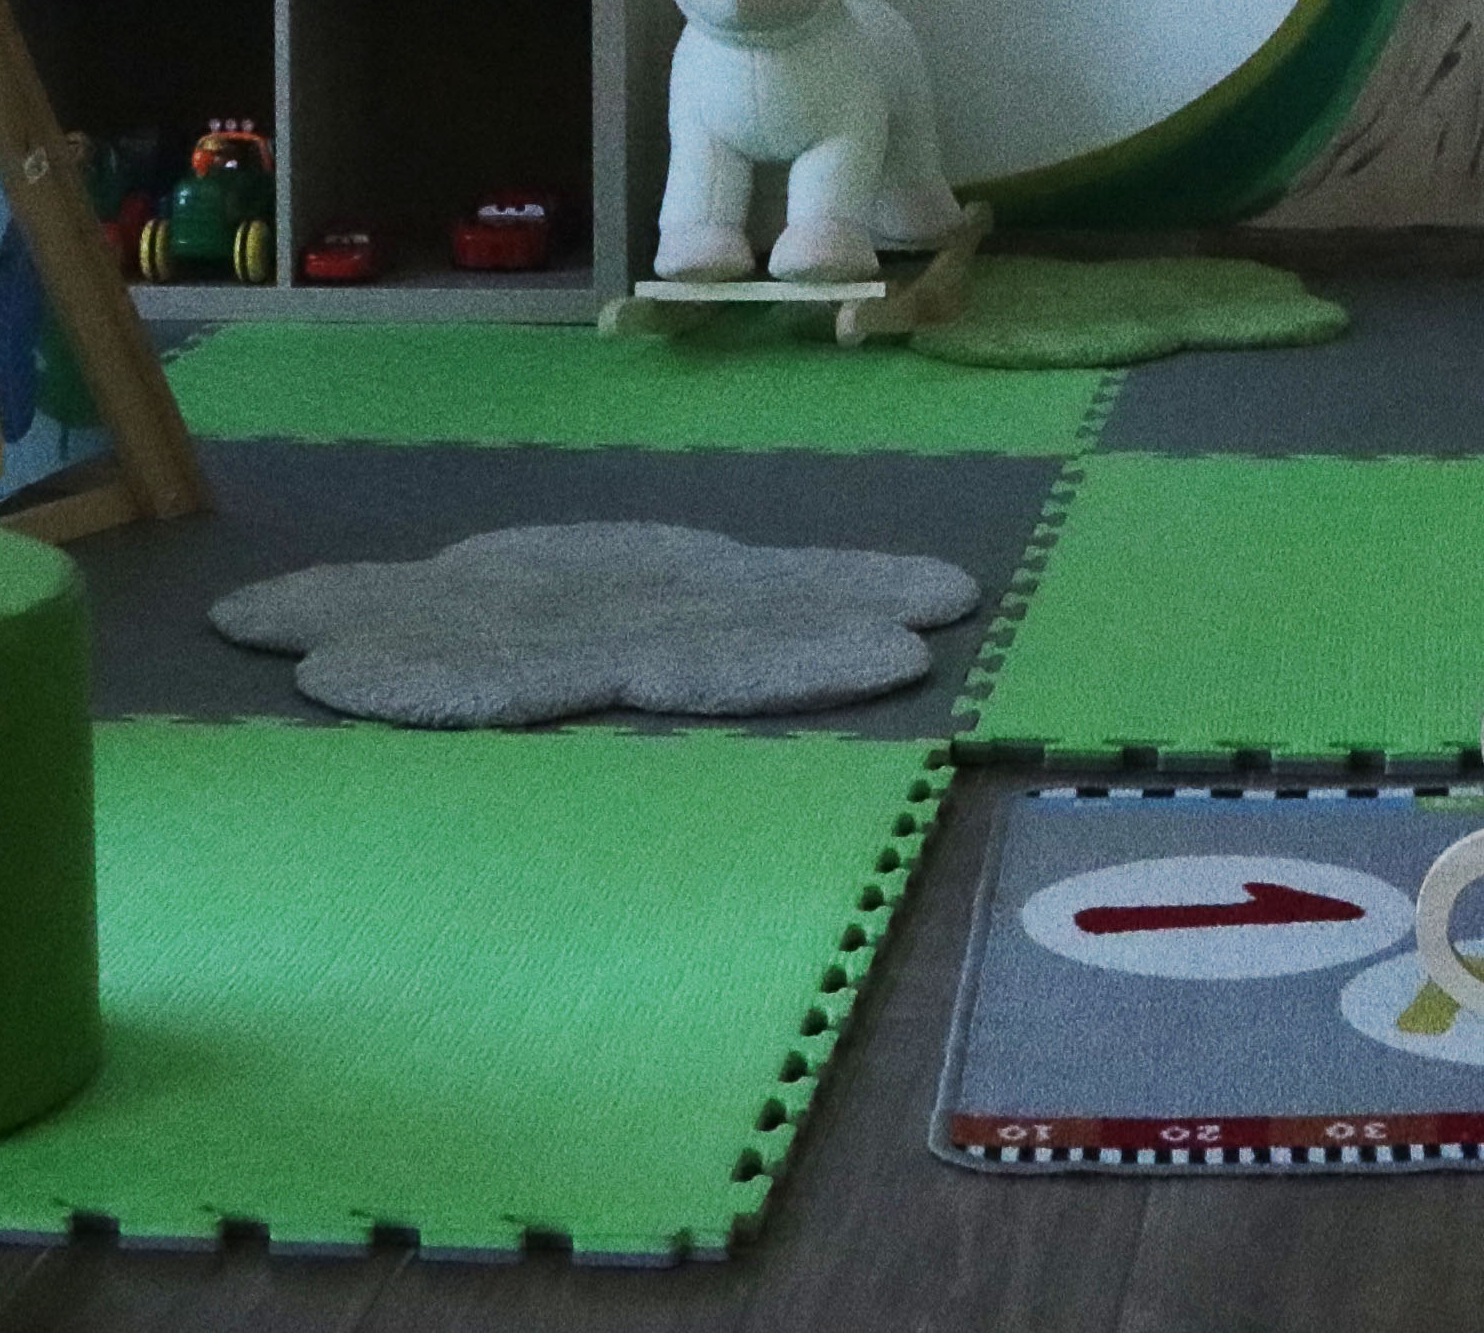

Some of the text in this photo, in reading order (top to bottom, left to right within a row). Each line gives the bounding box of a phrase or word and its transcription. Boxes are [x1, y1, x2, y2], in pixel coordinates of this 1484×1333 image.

[1075, 882, 1364, 934] 1
[997, 1124, 1053, 1141] 10
[1160, 1123, 1221, 1142] 20
[1325, 1121, 1388, 1140] 30
